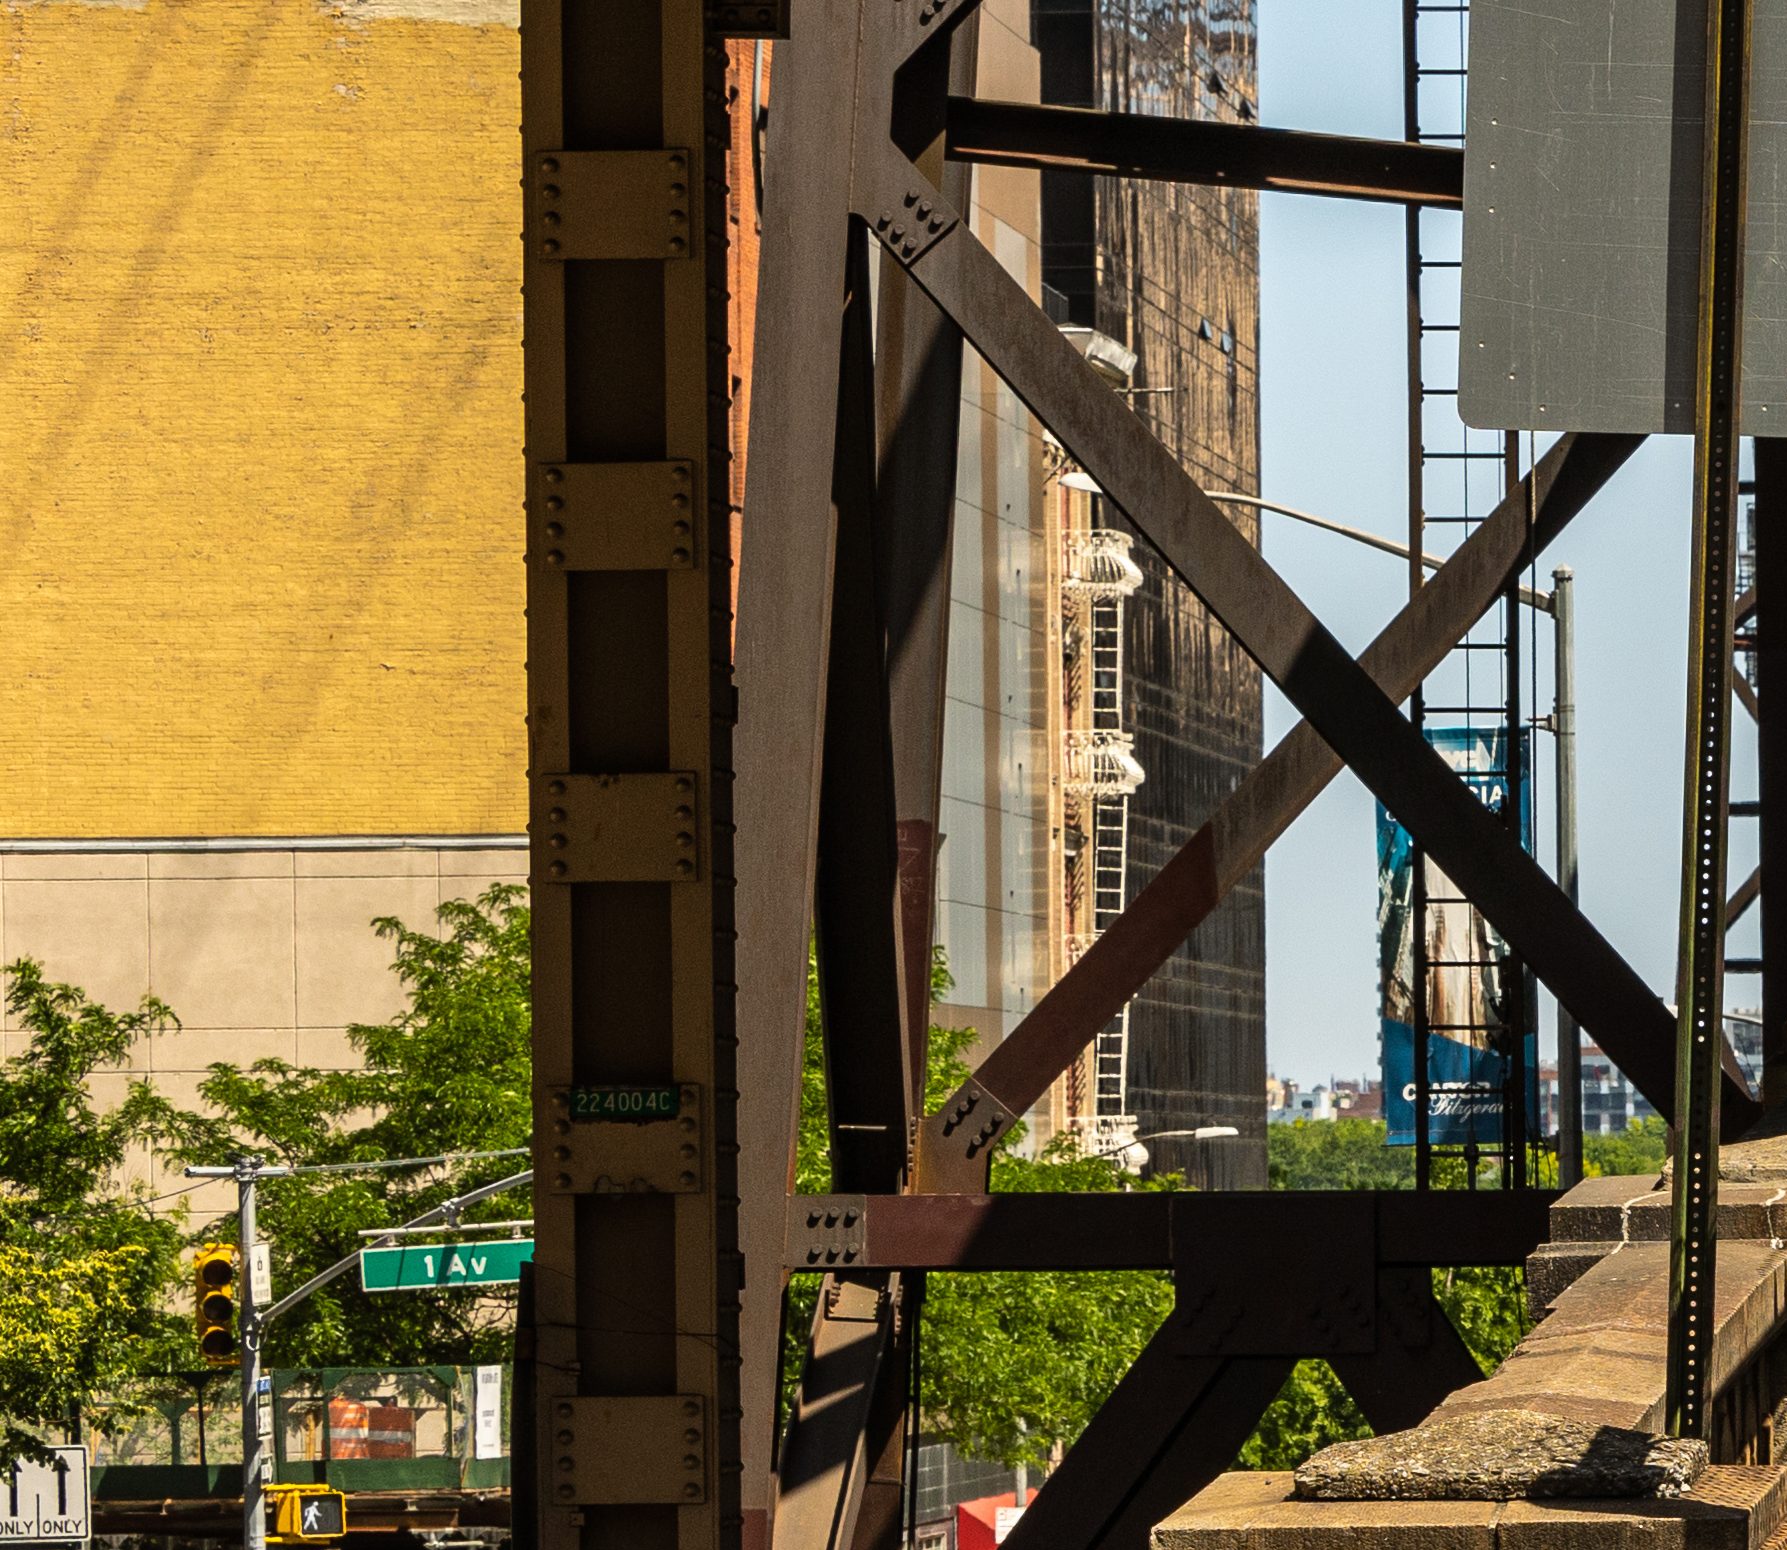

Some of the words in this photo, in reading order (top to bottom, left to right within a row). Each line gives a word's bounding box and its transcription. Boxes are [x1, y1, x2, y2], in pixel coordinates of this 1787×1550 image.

[577, 1092, 670, 1112] 224004C
[424, 1255, 434, 1278] 1
[447, 1253, 487, 1276] Av
[43, 1520, 82, 1534] ONLY
